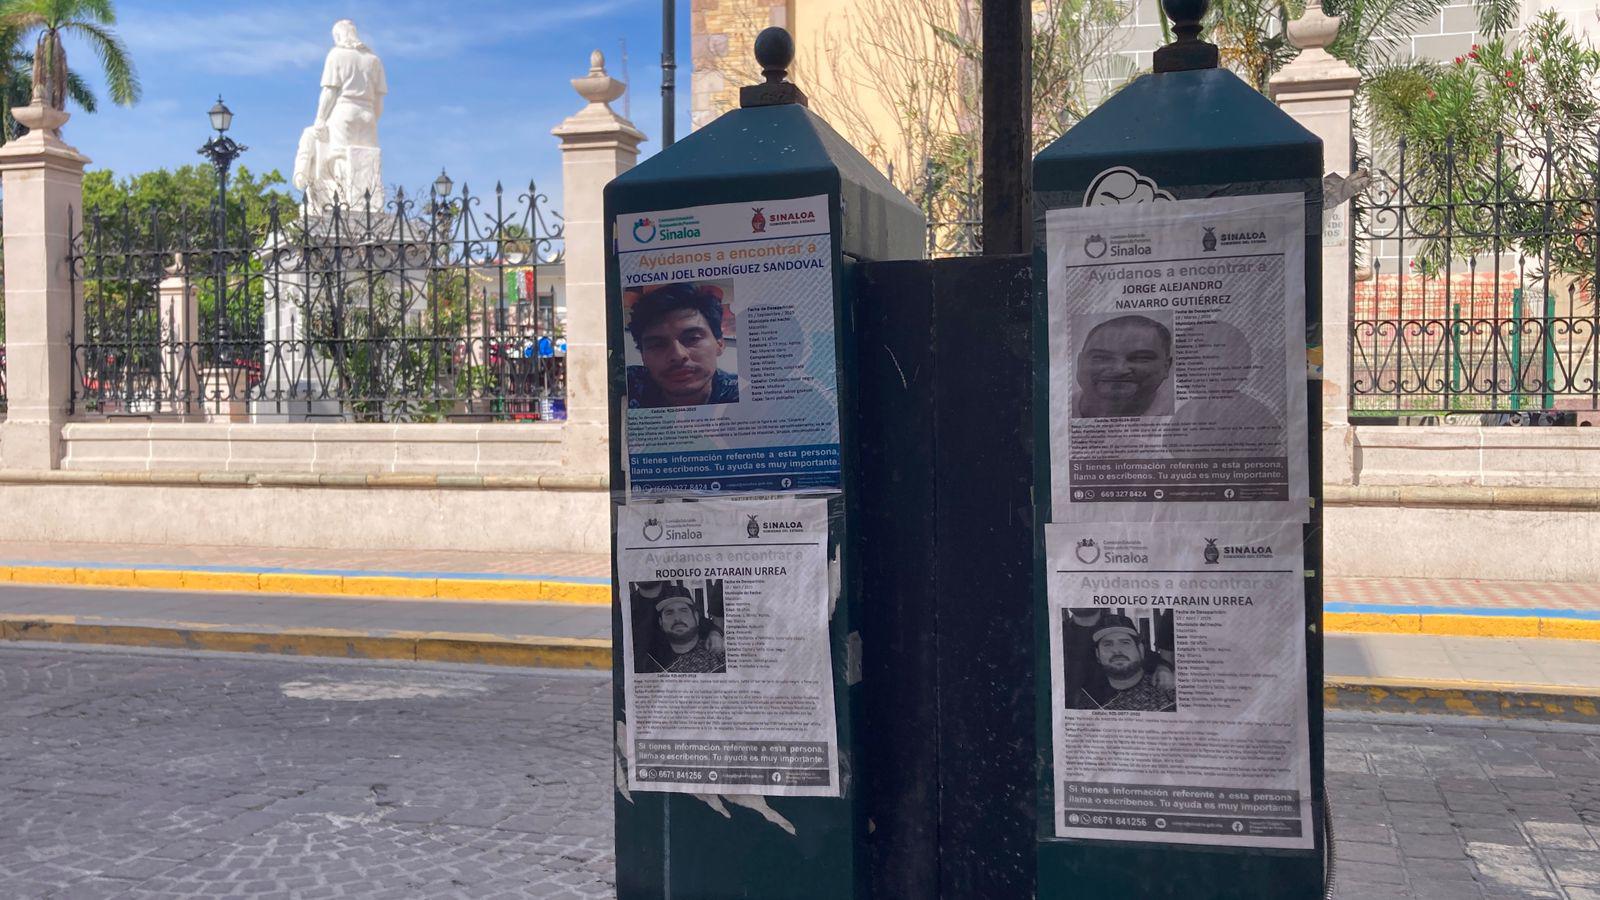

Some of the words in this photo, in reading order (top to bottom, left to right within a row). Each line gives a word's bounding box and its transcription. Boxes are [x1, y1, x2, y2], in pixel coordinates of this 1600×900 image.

[770, 211, 815, 222] SINALOA
[660, 228, 700, 241] Sinaloa
[1221, 232, 1266, 241] SINALOA
[1110, 244, 1152, 256] Sinaloa
[639, 252, 711, 270] Ayúdanos
[716, 252, 724, 260] a
[730, 244, 804, 259] encontrar
[808, 243, 816, 252] a
[626, 272, 668, 284] YOCSAN
[672, 270, 695, 280] JOEL
[698, 263, 760, 278] RODRÍGUEZ
[764, 258, 824, 272] SANDOVAL
[1089, 267, 1161, 282] Ayúdanos
[1167, 268, 1175, 277] a
[1180, 264, 1252, 276] encontrar
[1258, 264, 1266, 272] a
[1122, 284, 1156, 294] JORGE
[1160, 280, 1223, 292] ALEJANDRO
[1116, 298, 1168, 309] NAVARRO
[1172, 294, 1231, 306] GUTIÉRREZ
[631, 456, 639, 464] Si
[643, 455, 668, 464] tienes
[672, 452, 722, 463] información
[726, 450, 765, 460] referente
[778, 450, 796, 458] esta
[632, 466, 653, 475] llama
[727, 462, 753, 472] ayuda
[768, 460, 787, 469] muy
[790, 458, 840, 468] importante.
[1074, 463, 1082, 471] Si
[1086, 463, 1111, 471] tienes
[1115, 462, 1166, 470] información
[1170, 461, 1208, 470] referente
[1074, 472, 1096, 480] llama
[1170, 472, 1197, 481] ayuda
[1233, 471, 1284, 480] importante.
[666, 528, 702, 540] Sinaloa
[646, 550, 712, 566] Ayúdanos
[716, 552, 724, 562] a
[728, 550, 790, 561] encontrar
[794, 551, 803, 560] a
[1104, 552, 1148, 564] Sinaloa
[656, 569, 701, 578] RODOLFO
[704, 568, 752, 577] ZATARAIN
[755, 566, 786, 576] URREA
[1081, 576, 1160, 593] Ayúdanos
[1164, 580, 1174, 589] a
[1179, 578, 1256, 590] encontrar
[1093, 596, 1148, 605] RODOLFO
[1151, 596, 1209, 605] ZATARAIN
[1213, 596, 1253, 606] URREA
[675, 743, 720, 751] información
[724, 754, 748, 763] ayuda
[761, 756, 778, 764] muy
[780, 755, 824, 764] importante.
[659, 770, 675, 778] 6671
[1068, 785, 1078, 793] Si
[1082, 786, 1109, 795] tienes
[1113, 787, 1168, 796] información
[1172, 789, 1215, 799] referente
[1229, 792, 1249, 800] esta
[1069, 795, 1094, 804] llama
[1160, 799, 1170, 808] Tu
[1173, 800, 1202, 810] ayuda
[1218, 803, 1239, 813] muy
[1241, 802, 1295, 813] importante.
[1093, 816, 1113, 825] 6671
[1116, 817, 1147, 826] 841256
